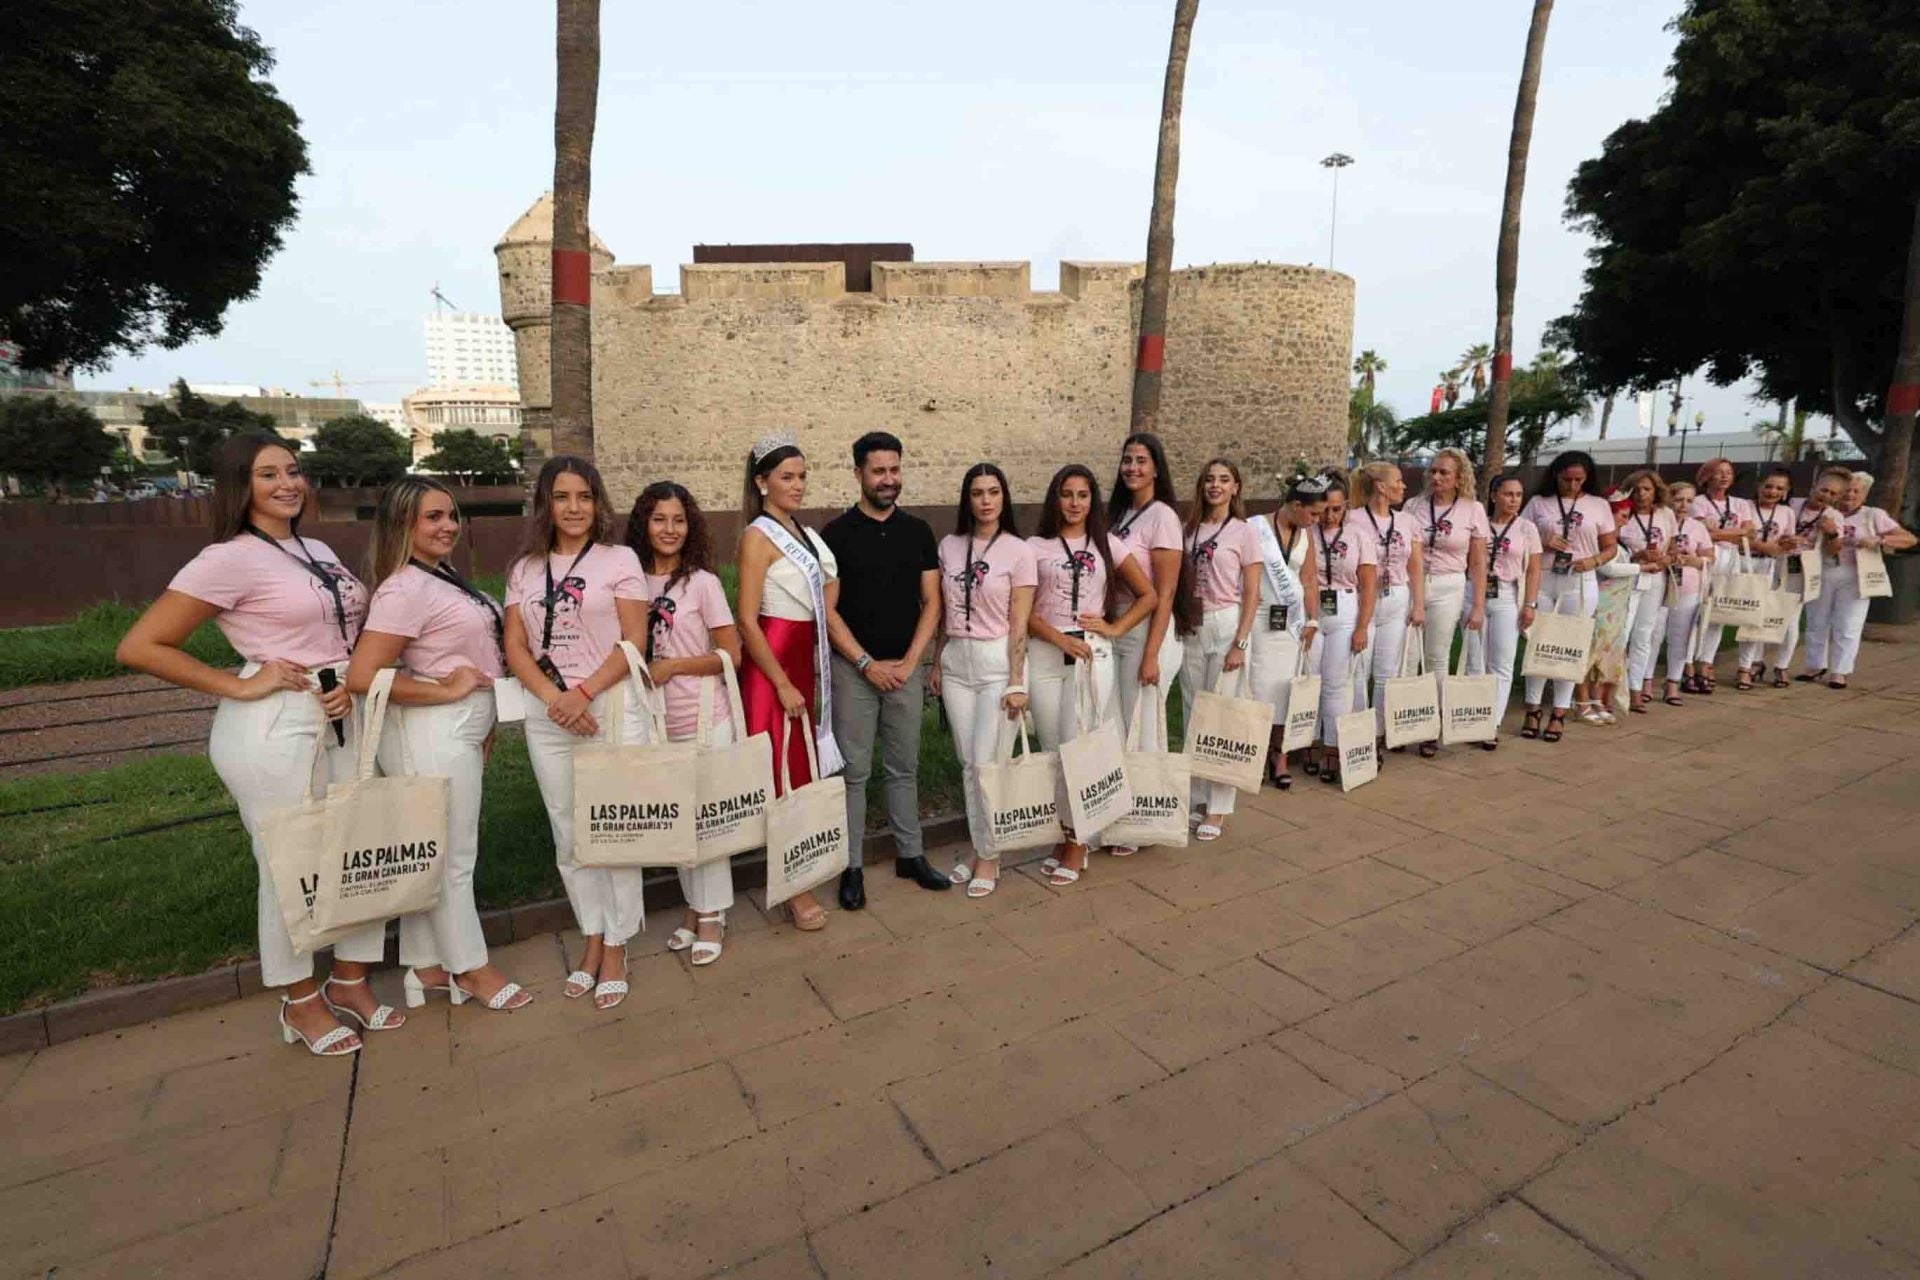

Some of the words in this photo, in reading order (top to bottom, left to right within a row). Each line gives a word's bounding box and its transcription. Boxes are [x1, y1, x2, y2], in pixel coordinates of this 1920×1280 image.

[784, 541, 815, 571] REINA
[1196, 733, 1216, 747] LAS
[1216, 737, 1258, 756] PALMAS
[1080, 784, 1098, 802] LAS
[1097, 767, 1123, 794] PALMAS
[590, 804, 617, 820] LAS
[620, 803, 679, 820] PALMAS
[695, 803, 717, 820] LAS
[719, 788, 766, 815] PALMAS
[994, 812, 1012, 825] LAS
[1013, 803, 1056, 822] PALMAS
[1135, 796, 1178, 809] PALMAS
[590, 822, 600, 832] DE
[602, 822, 624, 832] GRAN
[342, 849, 373, 871] LAS
[375, 840, 437, 866] PALMAS
[783, 845, 800, 865] LAS
[800, 827, 841, 855] PALMAS
[341, 873, 353, 884] DE
[355, 868, 380, 882] GRAN
